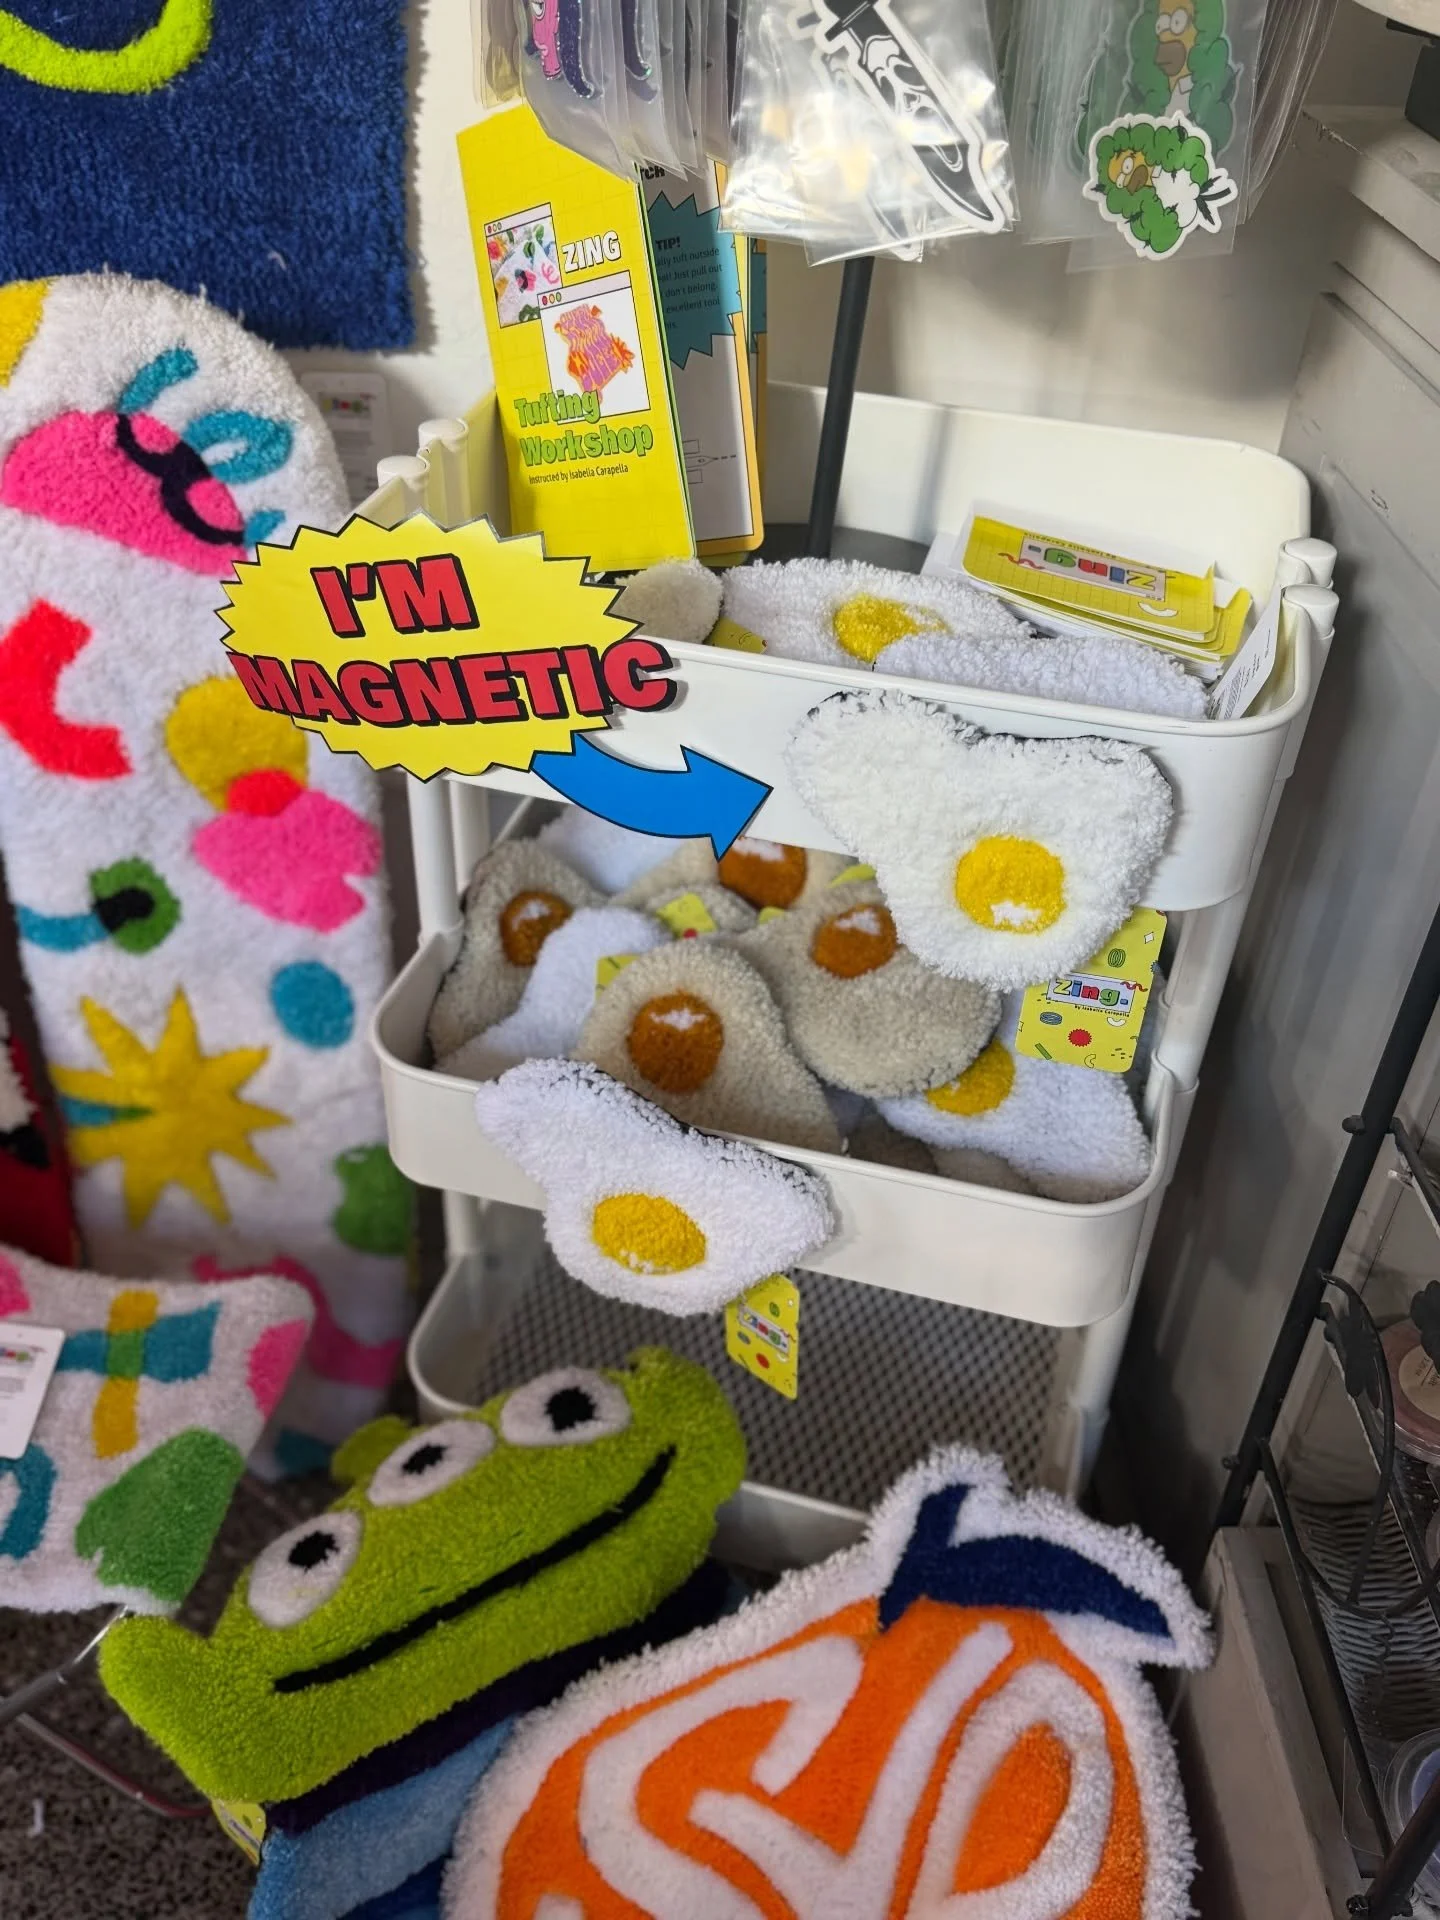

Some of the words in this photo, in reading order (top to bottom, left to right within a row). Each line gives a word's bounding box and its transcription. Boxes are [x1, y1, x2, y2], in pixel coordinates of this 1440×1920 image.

[561, 230, 622, 274] ZING
[655, 236, 681, 251] TIP!
[689, 247, 720, 260] outside
[674, 269, 690, 282] Just
[691, 265, 708, 280] pull
[708, 264, 723, 275] out
[704, 296, 721, 309] tool
[514, 389, 601, 428] Tufting
[520, 424, 654, 467] Workshop
[529, 471, 559, 485] Instructed
[561, 471, 569, 483] by
[570, 466, 595, 480] Isabella
[596, 463, 629, 477] Carapella
[310, 553, 480, 638] I'M
[226, 638, 678, 728] MAGNETIC
